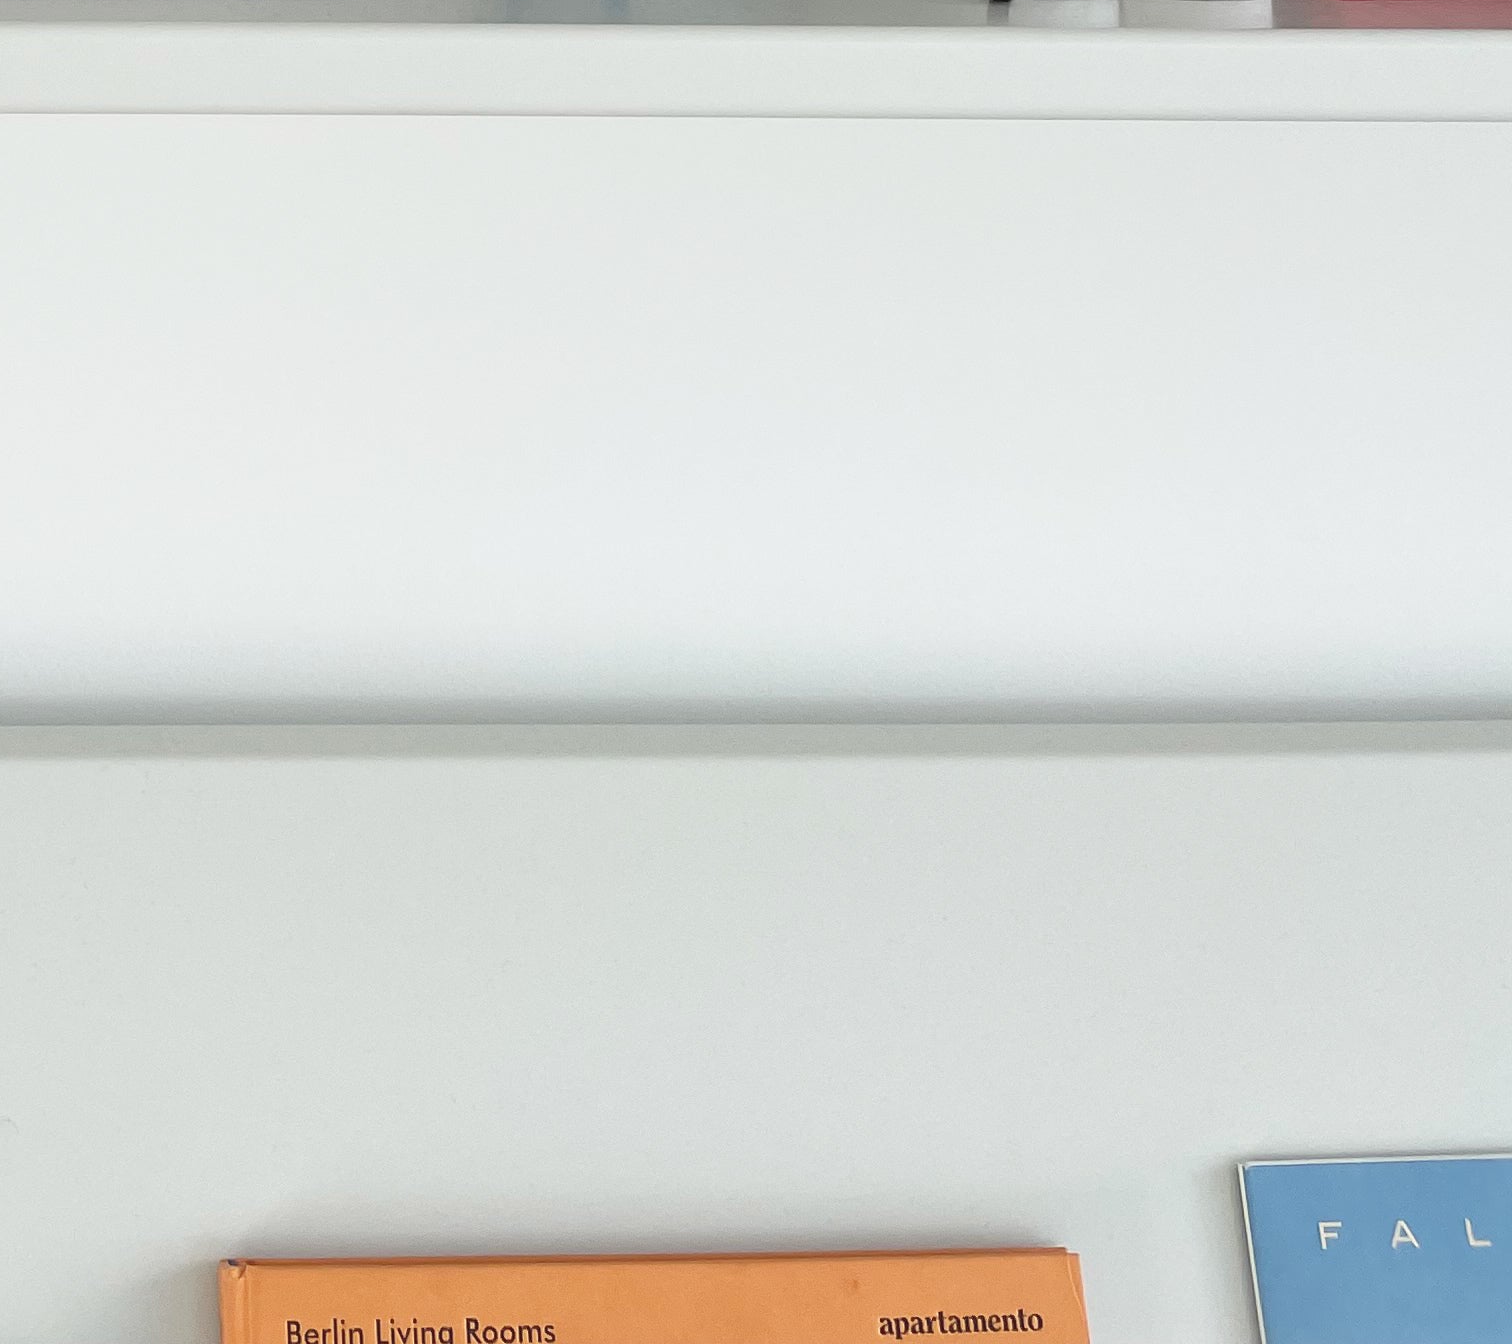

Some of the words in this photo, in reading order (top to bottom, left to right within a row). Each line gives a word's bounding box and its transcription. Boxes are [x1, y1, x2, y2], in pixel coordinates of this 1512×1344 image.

[286, 1318, 365, 1344] Berlin
[466, 1318, 556, 1344] Rooms
[879, 1308, 1045, 1340] apartamento
